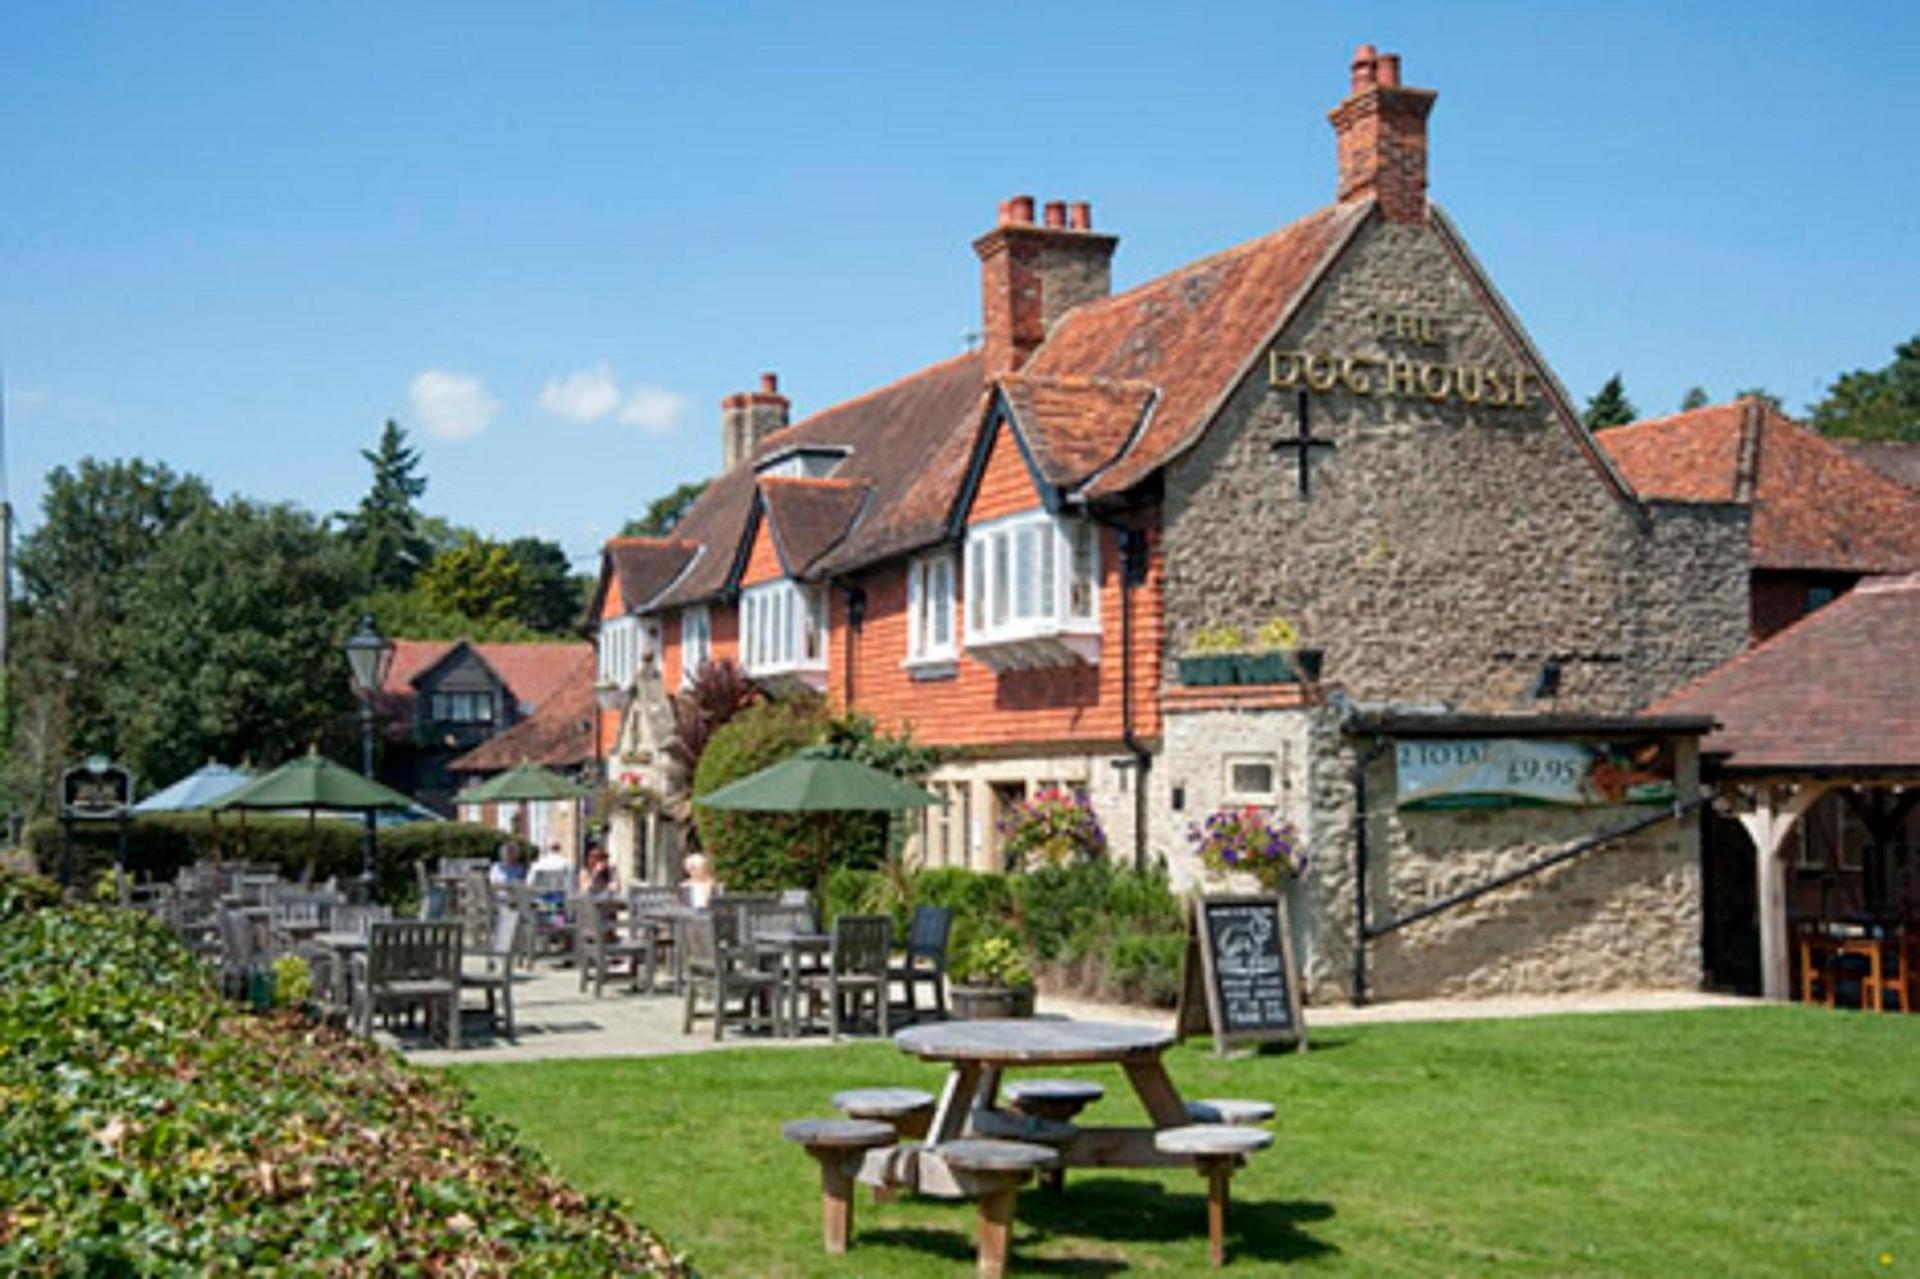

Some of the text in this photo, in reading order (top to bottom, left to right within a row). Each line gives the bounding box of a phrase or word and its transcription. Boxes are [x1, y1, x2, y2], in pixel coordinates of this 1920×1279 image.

[1268, 350, 1538, 406] DOG HOUSE
[1507, 759, 1576, 786] £9.95
